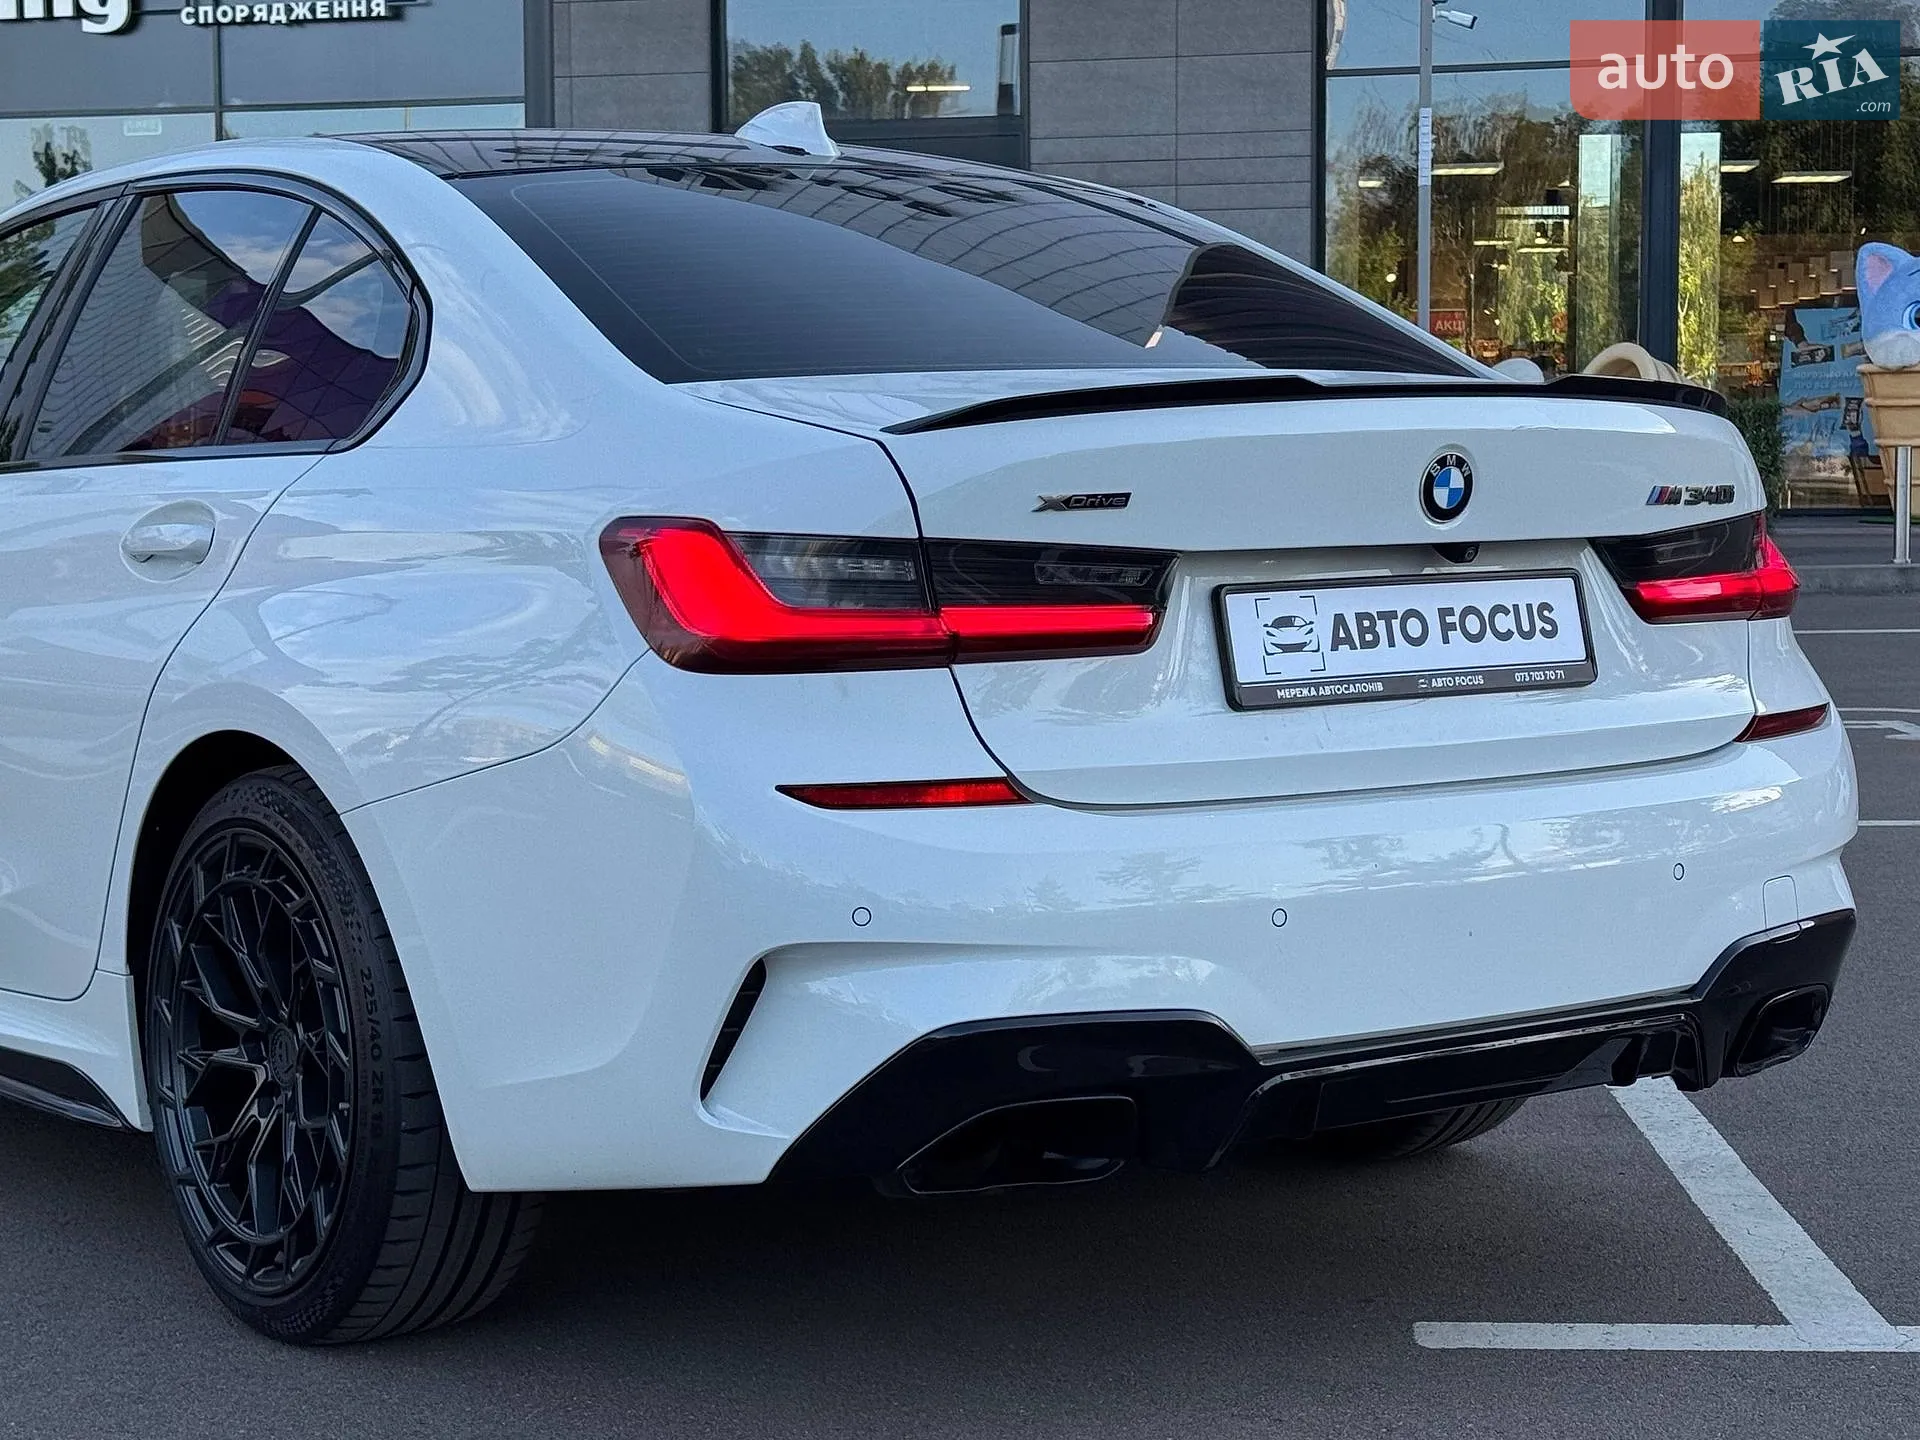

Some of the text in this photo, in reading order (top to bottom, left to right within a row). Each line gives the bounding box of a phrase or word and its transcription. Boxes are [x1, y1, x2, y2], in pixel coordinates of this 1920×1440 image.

[180, 0, 388, 25] СПОРЯДЖЕННЯ
[1430, 454, 1471, 477] BMW
[1330, 601, 1559, 651] АВТО FOCUS
[1431, 675, 1485, 688] АВТО FOCUS
[1515, 669, 1566, 682] 073 703 70 71
[1276, 681, 1384, 699] МЕРЕЖА АВТОСАЛОНІВ
[359, 966, 383, 1062] 225/40
